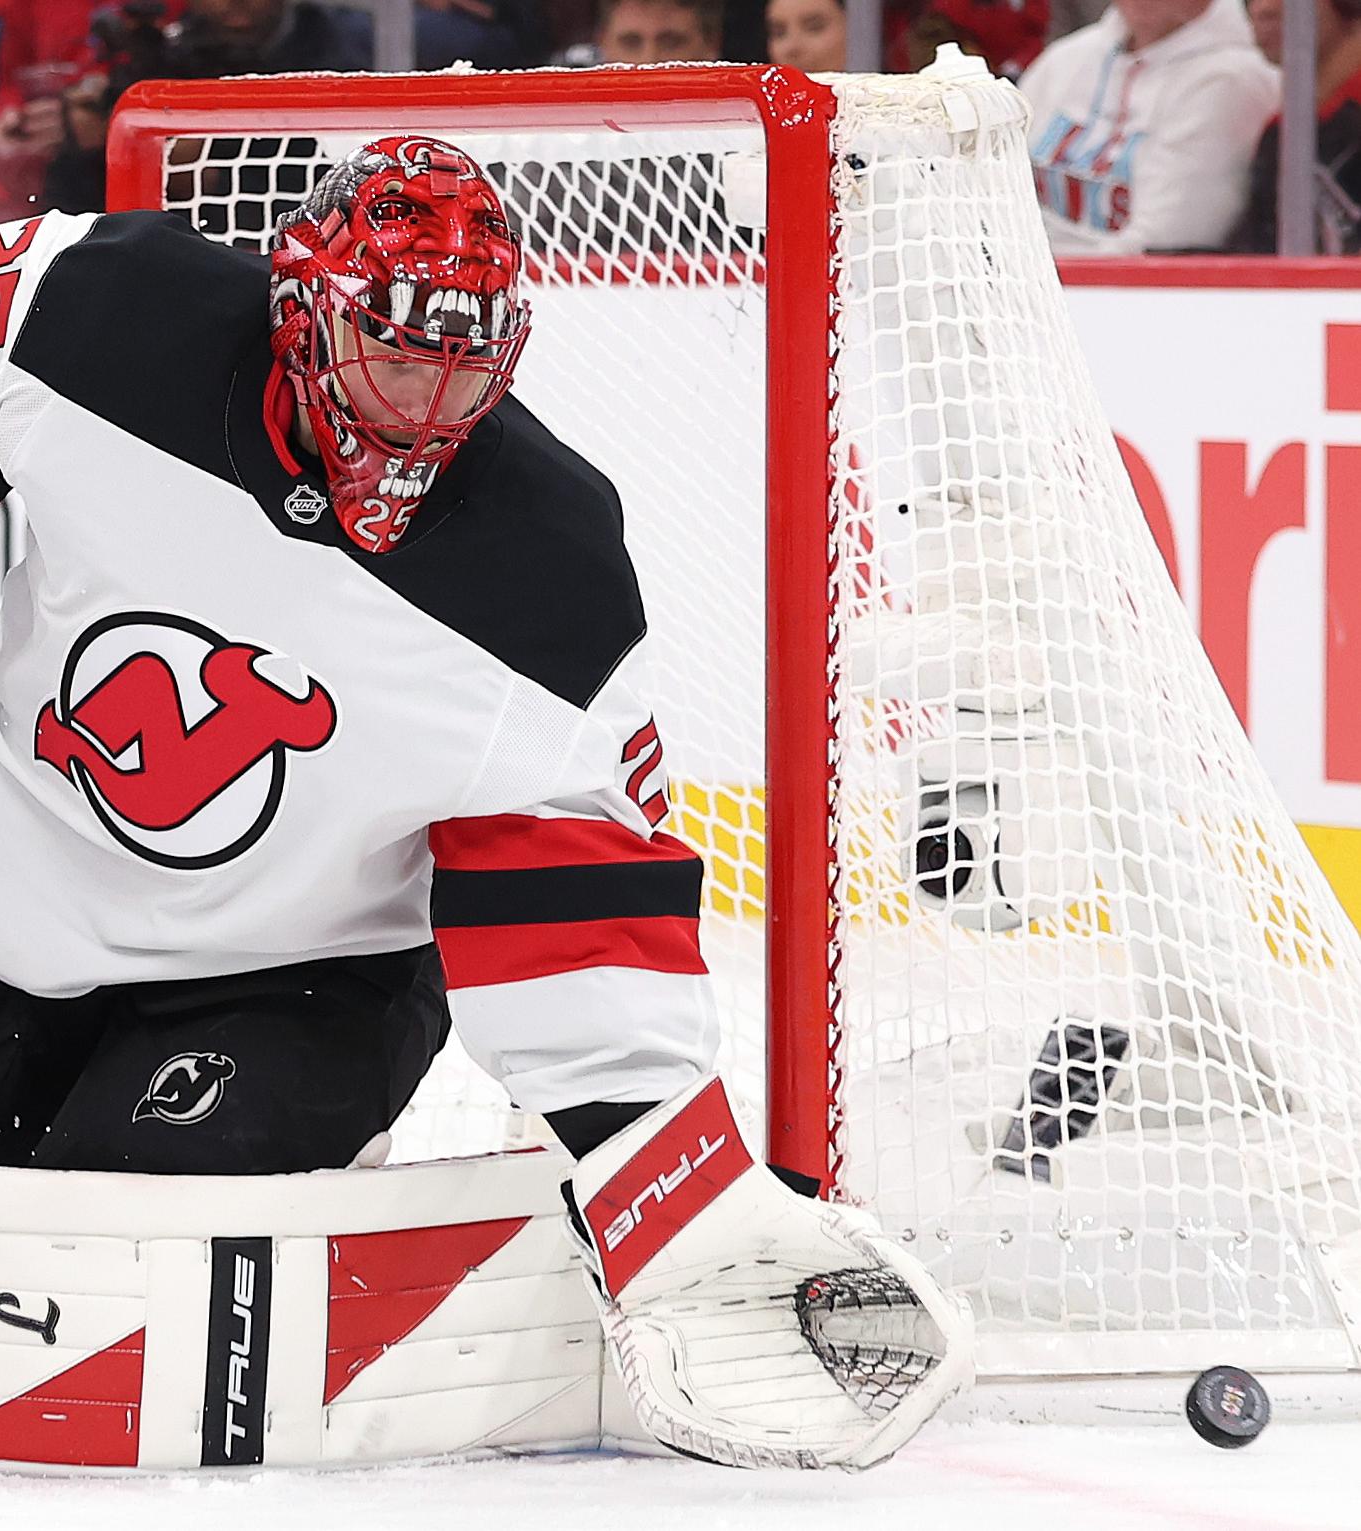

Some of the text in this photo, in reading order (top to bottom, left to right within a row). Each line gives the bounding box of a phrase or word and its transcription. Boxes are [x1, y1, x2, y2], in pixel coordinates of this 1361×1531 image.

[354, 498, 420, 546] 25
[603, 1133, 727, 1253] TRUE
[223, 1252, 257, 1461] TRUE
